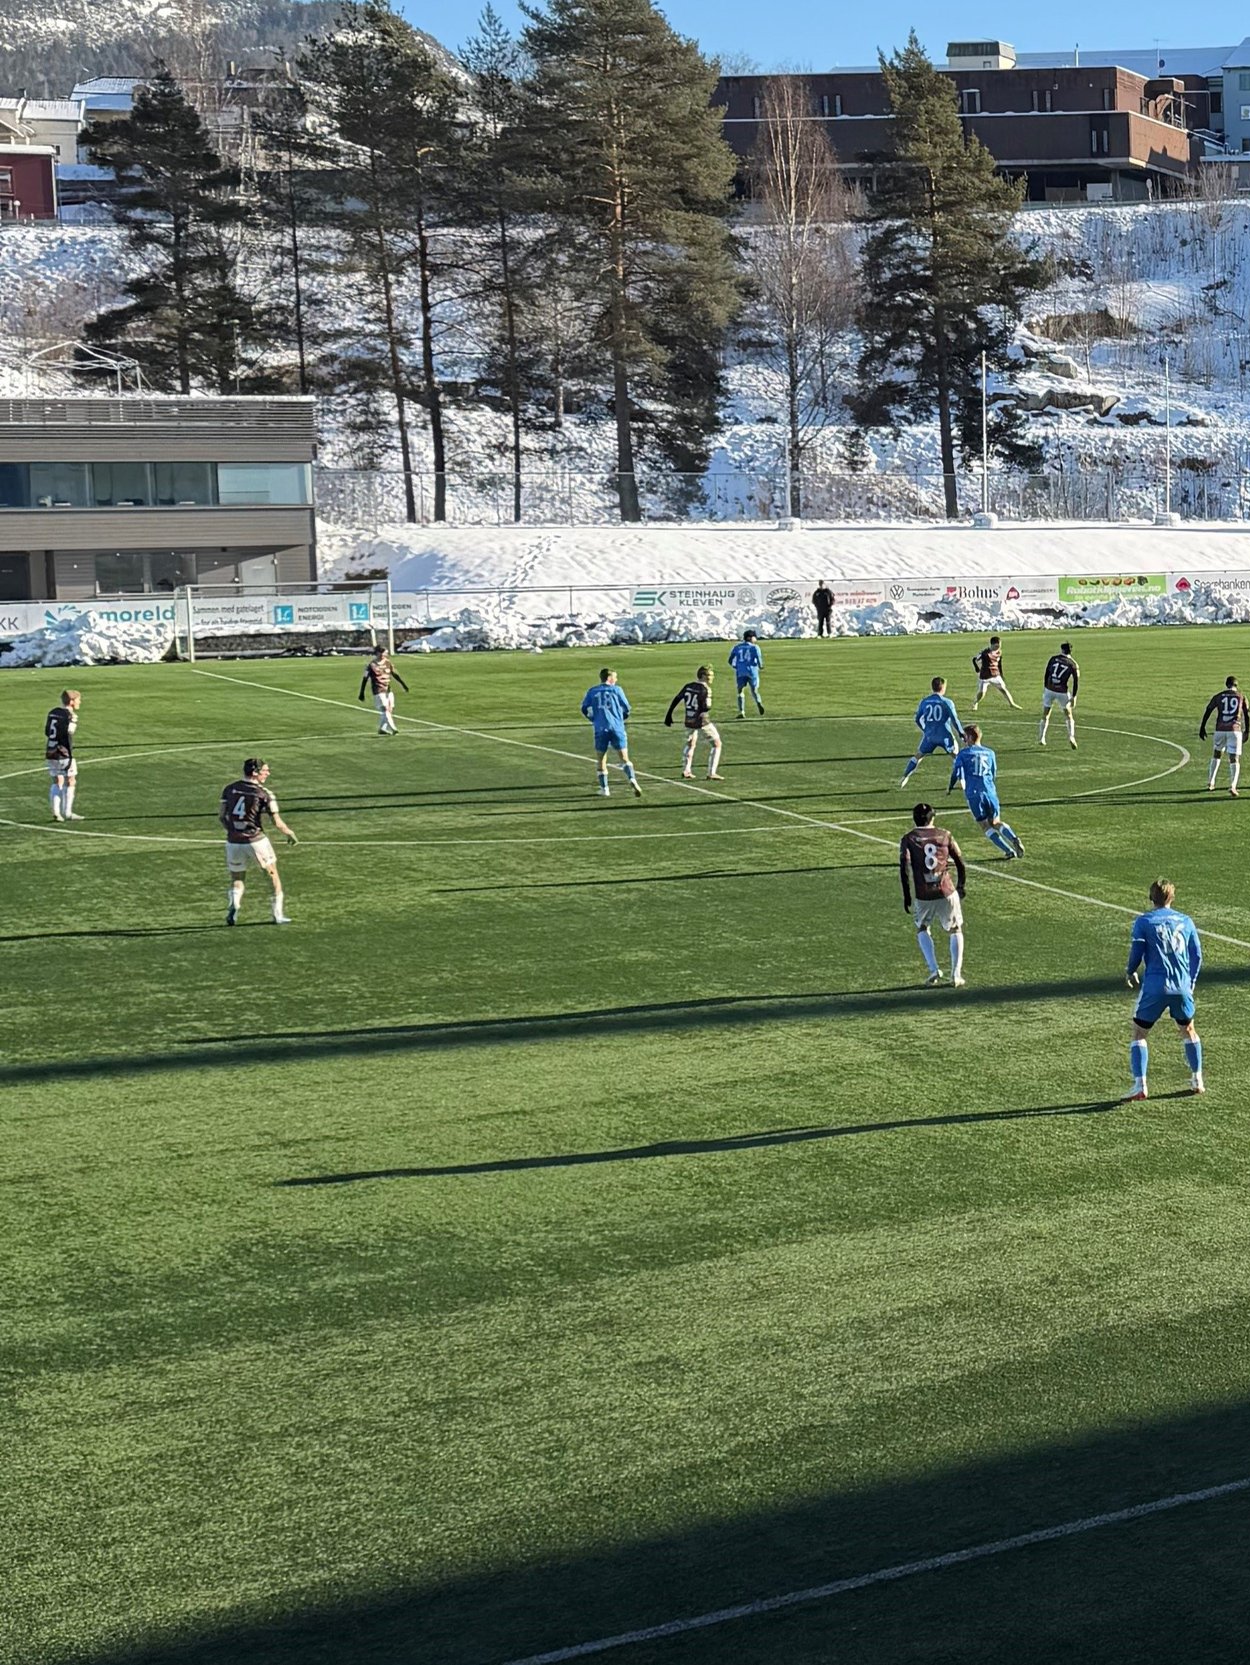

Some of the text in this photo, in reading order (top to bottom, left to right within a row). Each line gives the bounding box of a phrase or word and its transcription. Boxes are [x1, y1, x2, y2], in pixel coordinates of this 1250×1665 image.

[669, 590, 735, 599] STEINHAUG
[959, 586, 999, 599] Bohus
[679, 599, 723, 607] KLEVEN
[101, 605, 175, 622] moreld
[1052, 662, 1069, 678] 17
[684, 691, 699, 710] 24
[1221, 696, 1239, 714] 19
[925, 704, 943, 721] 20
[49, 719, 58, 738] 5
[232, 795, 246, 820] 4
[924, 843, 938, 870] 8
